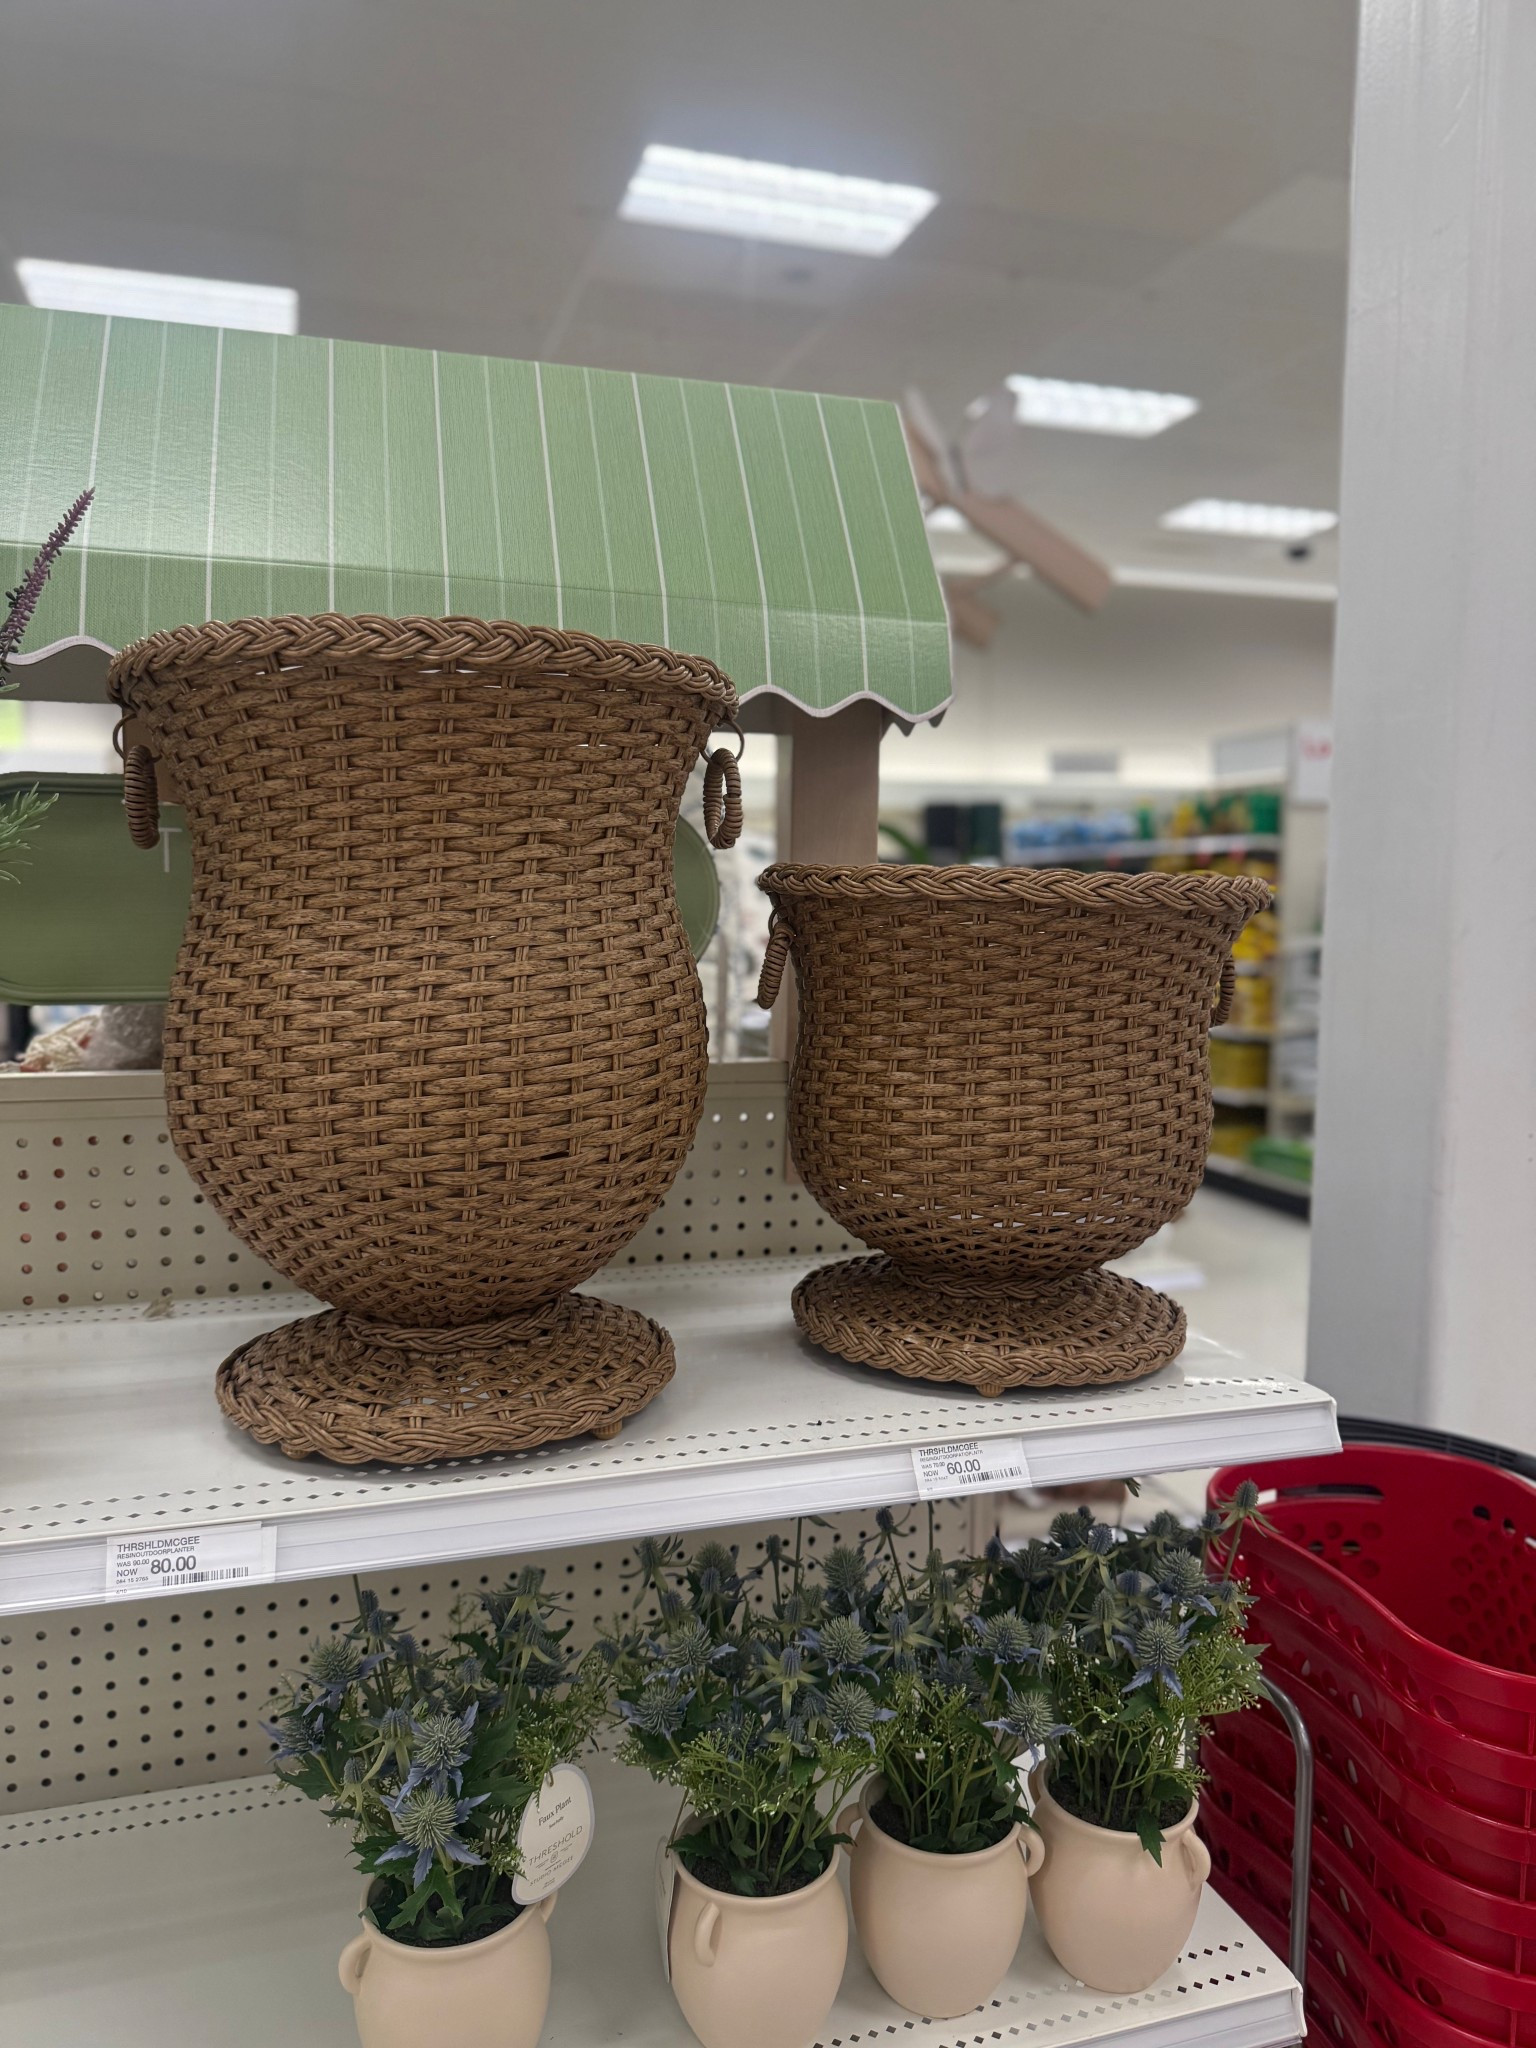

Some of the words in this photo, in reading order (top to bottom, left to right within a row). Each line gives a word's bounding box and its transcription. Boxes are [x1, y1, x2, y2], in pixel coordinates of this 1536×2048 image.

[918, 1442, 979, 1457] THRSHLDMCGEE
[923, 1469, 939, 1477] NOW
[946, 1459, 981, 1475] 60.00
[116, 1535, 200, 1553] THRSHLDMCGEE
[116, 1546, 195, 1560] RESINOUTDOORPLANTER
[116, 1568, 138, 1577] NOW
[150, 1555, 197, 1575] 80.00
[132, 1558, 150, 1566] 90.00
[538, 1810, 555, 1826] Faux
[555, 1796, 572, 1814] Plant
[528, 1825, 583, 1867] THRESHOLD
